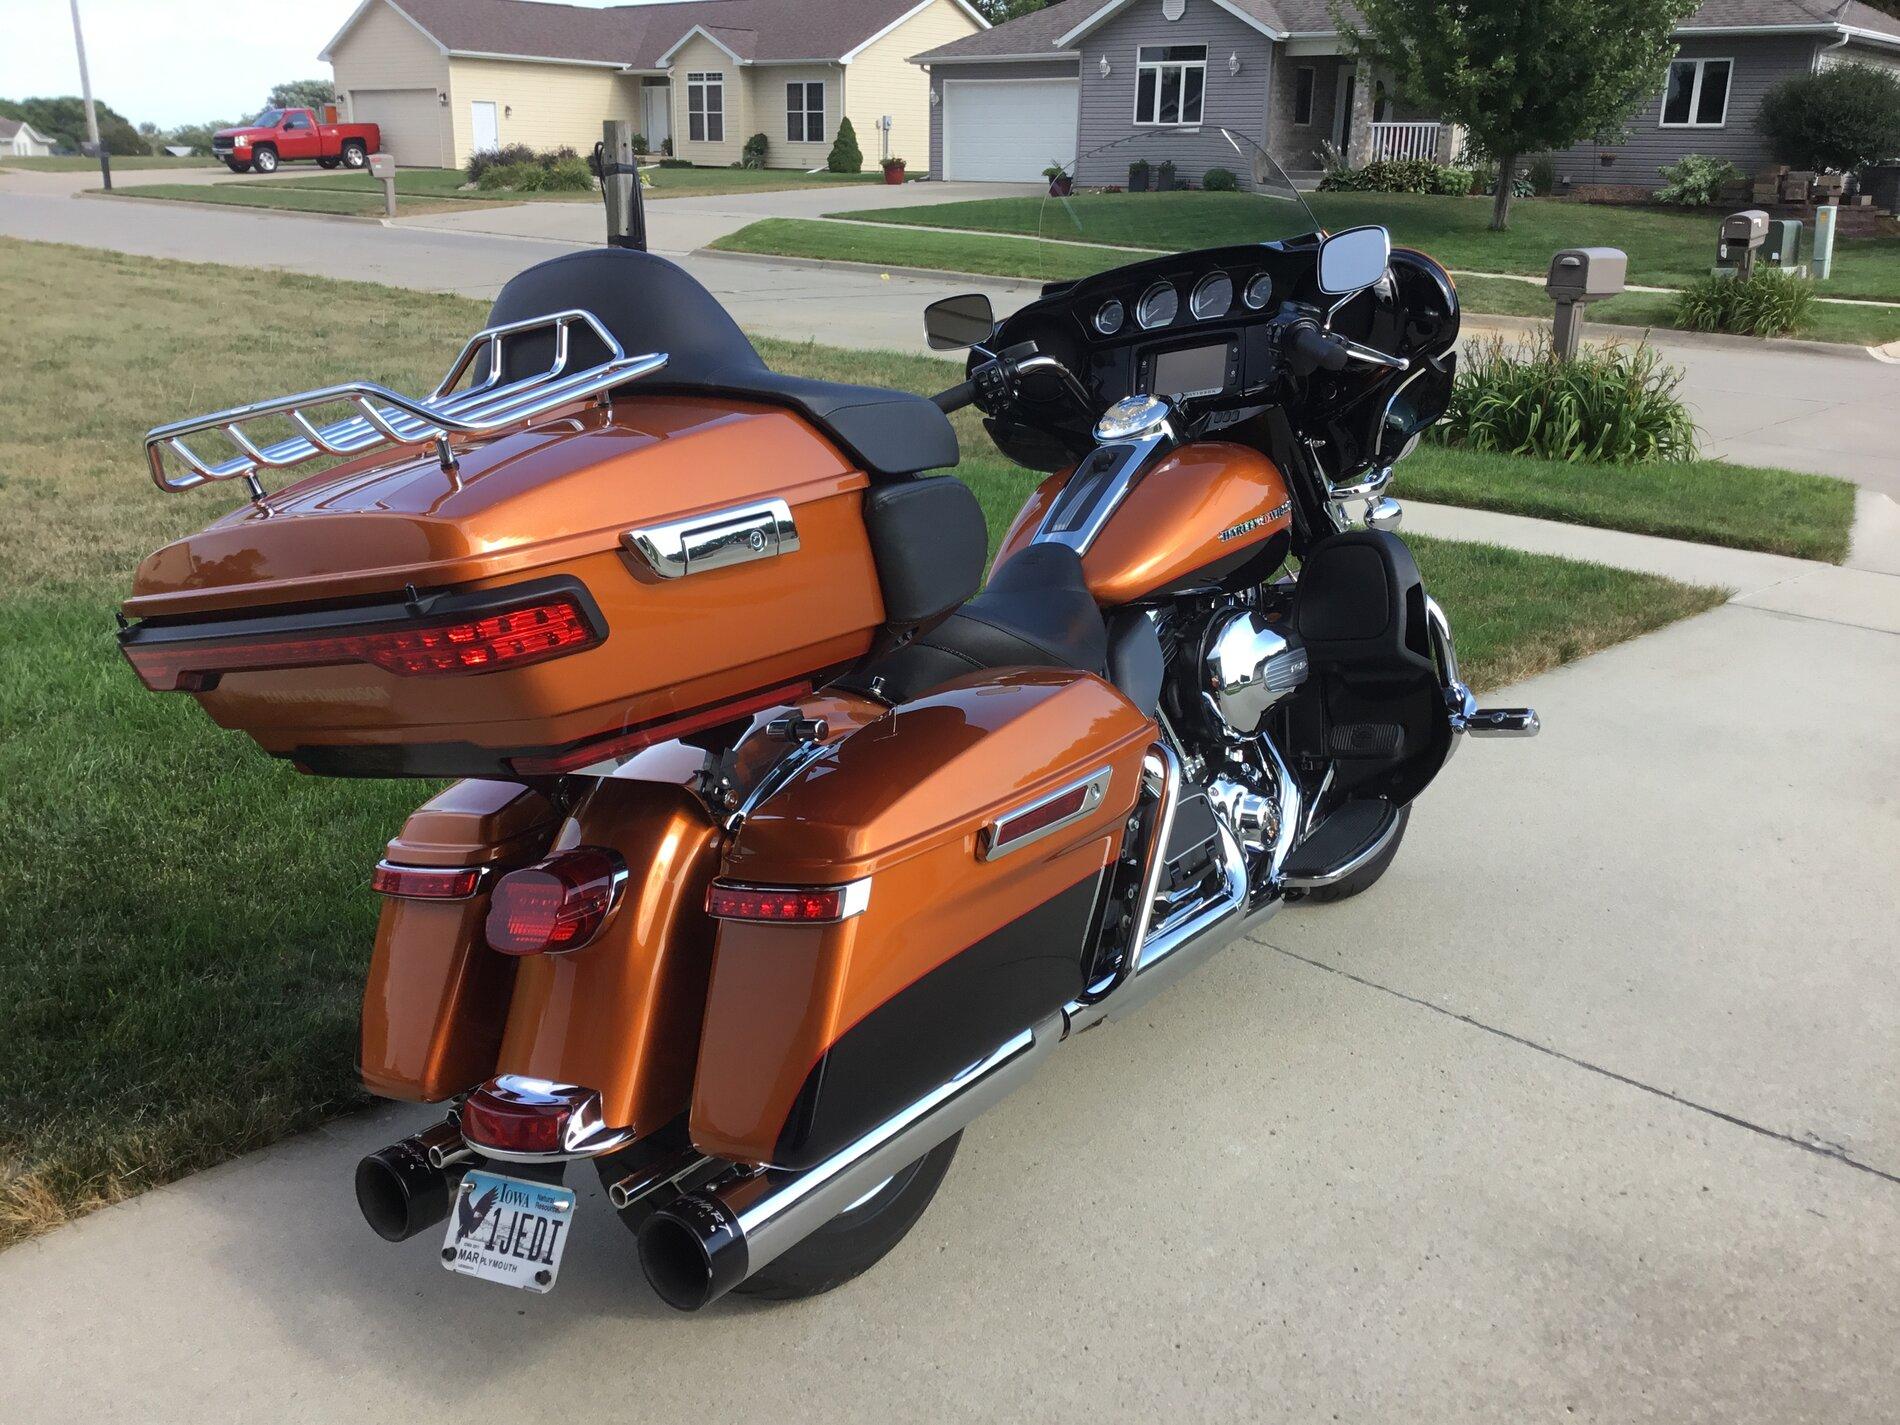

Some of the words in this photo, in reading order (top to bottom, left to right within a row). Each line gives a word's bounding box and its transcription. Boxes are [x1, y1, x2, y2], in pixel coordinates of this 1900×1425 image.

[484, 1207, 564, 1266] 1JEDI
[457, 1248, 480, 1265] MAR
[480, 1257, 518, 1273] PLYMOUTH
